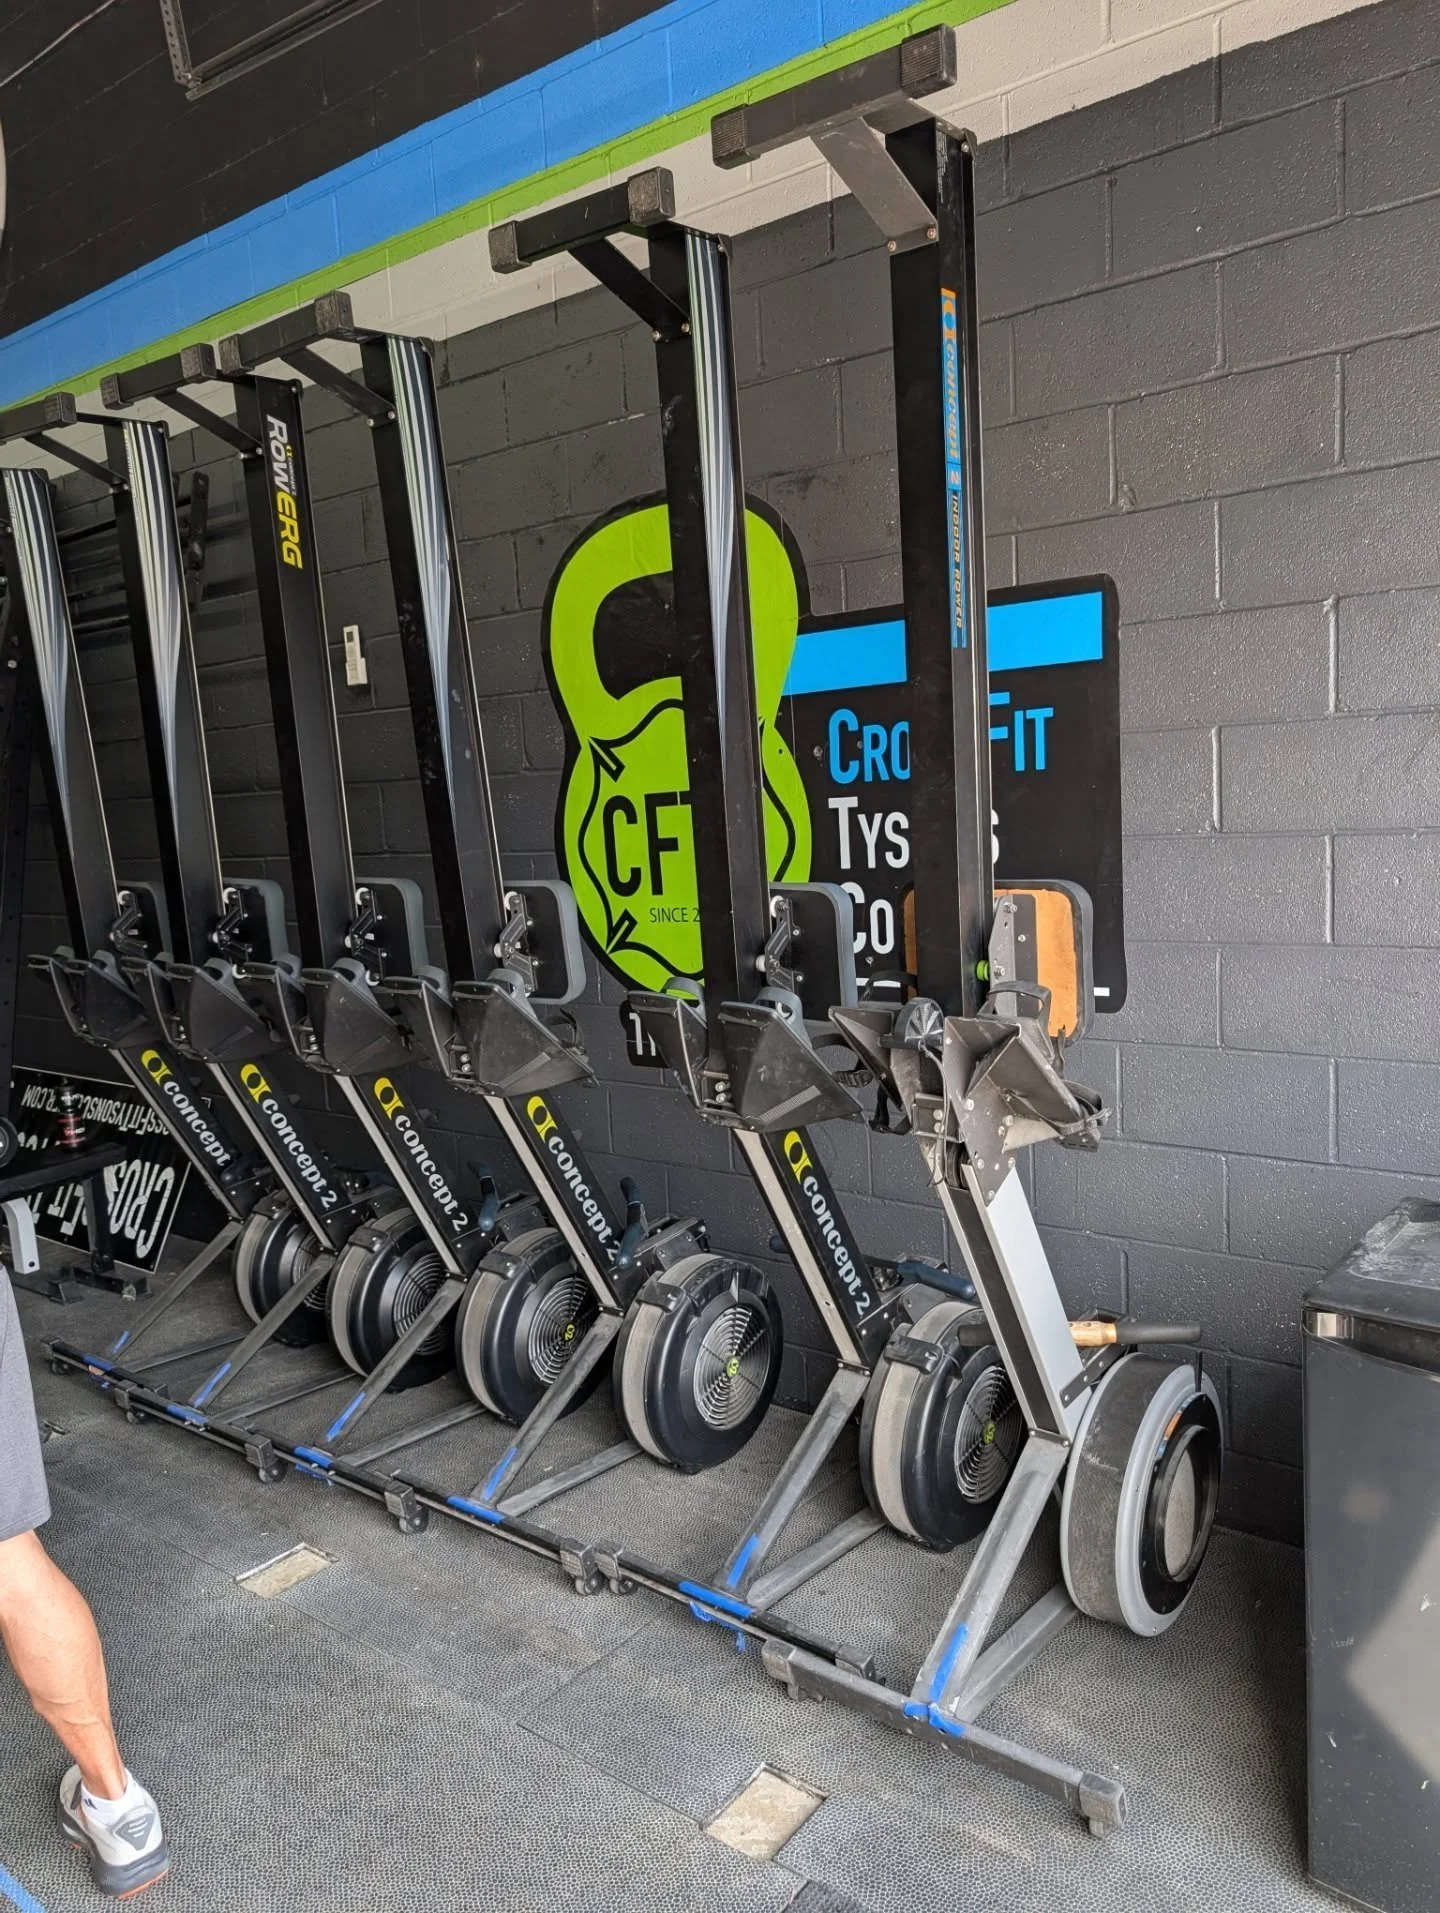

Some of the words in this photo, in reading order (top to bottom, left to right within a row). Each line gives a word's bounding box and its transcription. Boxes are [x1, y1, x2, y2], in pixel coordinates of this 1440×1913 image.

[950, 470, 960, 484] 2
[952, 495, 961, 563] INDOOR
[954, 568, 963, 629] ROWER
[649, 907, 689, 923] SINCE
[164, 1081, 231, 1167] concept
[261, 1098, 327, 1192] concept
[320, 1190, 338, 1208] 2
[395, 1114, 459, 1215] concept
[452, 1212, 469, 1232] 2
[548, 1136, 613, 1244] concept
[606, 1240, 621, 1262] 2
[803, 1175, 862, 1296] concept
[855, 1291, 871, 1316] 2
